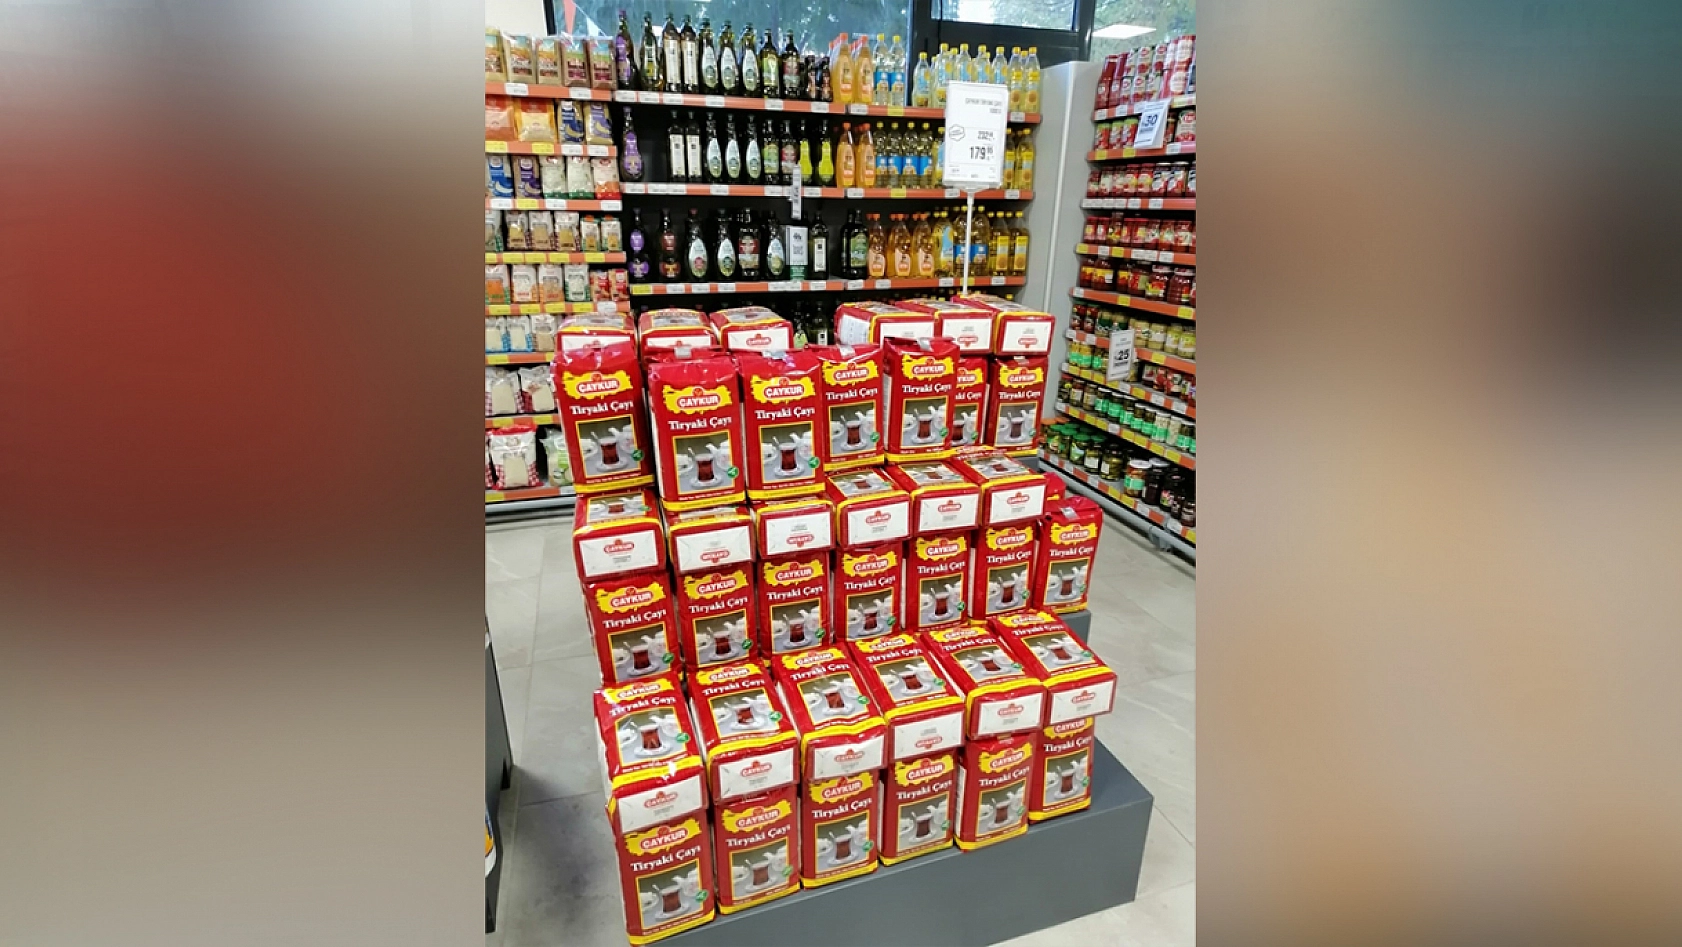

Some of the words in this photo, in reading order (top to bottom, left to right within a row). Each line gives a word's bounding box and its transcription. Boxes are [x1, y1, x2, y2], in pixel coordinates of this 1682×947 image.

[969, 146, 986, 160] 179
[834, 369, 868, 381] ÇAYKUR
[913, 365, 945, 376] ÇAYKUR
[1008, 373, 1037, 384] ÇAYKUR
[578, 381, 619, 393] ÇAYKUR
[765, 386, 803, 398] ÇAYKUR
[825, 389, 858, 401] Tiryaki
[859, 387, 878, 398] Çayı
[902, 384, 933, 396] Tiryaki
[934, 383, 952, 393] Çayı
[678, 395, 719, 408] ÇAYKUR
[998, 390, 1026, 401] Tiryaki
[569, 402, 609, 416] Tiryaki
[610, 401, 634, 412] Çayı
[755, 408, 793, 421] Tiryaki
[794, 407, 816, 419] Çayı
[668, 418, 707, 432] Tiryaki
[709, 416, 733, 428] Çayı
[997, 533, 1026, 546] ÇAYKUR
[1061, 531, 1089, 540] ÇAYKUR
[927, 544, 958, 556] ÇAYKUR
[854, 559, 889, 572] ÇAYKUR
[986, 553, 1014, 564] Tiryaki
[777, 567, 813, 580] ÇAYKUR
[917, 563, 948, 575] Tiryaki
[949, 561, 965, 572] Çayı
[699, 579, 737, 594] ÇAYKUR
[844, 578, 877, 591] Tiryaki
[878, 575, 895, 588] Çayı
[611, 592, 652, 607] ÇAYKUR
[767, 588, 802, 602] Tiryaki
[803, 585, 823, 597] Çayı
[689, 601, 726, 614] Tiryaki
[727, 597, 748, 609] Çayı
[603, 615, 642, 629] Tiryaki
[644, 610, 667, 622] Çayı
[710, 668, 750, 682] ÇAYKUR
[790, 667, 827, 681] Tiryaki
[619, 684, 660, 699] ÇAYKUR
[702, 683, 740, 696] Tiryaki
[742, 679, 766, 690] Çayı
[651, 696, 676, 707] Çayı
[1055, 718, 1086, 732] ÇAYKUR
[1044, 740, 1075, 753] Tiryaki
[992, 752, 1024, 769] ÇAYKUR
[908, 764, 944, 780] ÇAYKUR
[979, 774, 1011, 787] Tiryaki
[822, 781, 862, 799] ÇAYKUR
[896, 785, 931, 800] Tiryaki
[932, 780, 953, 793] Çayı
[811, 804, 849, 820] Tiryaki
[851, 798, 872, 812] Çayı
[738, 809, 779, 828] ÇAYKUR
[641, 829, 687, 849] ÇAYKUR
[726, 832, 766, 847] Tiryaki
[768, 824, 790, 839] Çayı
[630, 855, 674, 872] Tiryaki
[676, 846, 701, 860] Çayı
